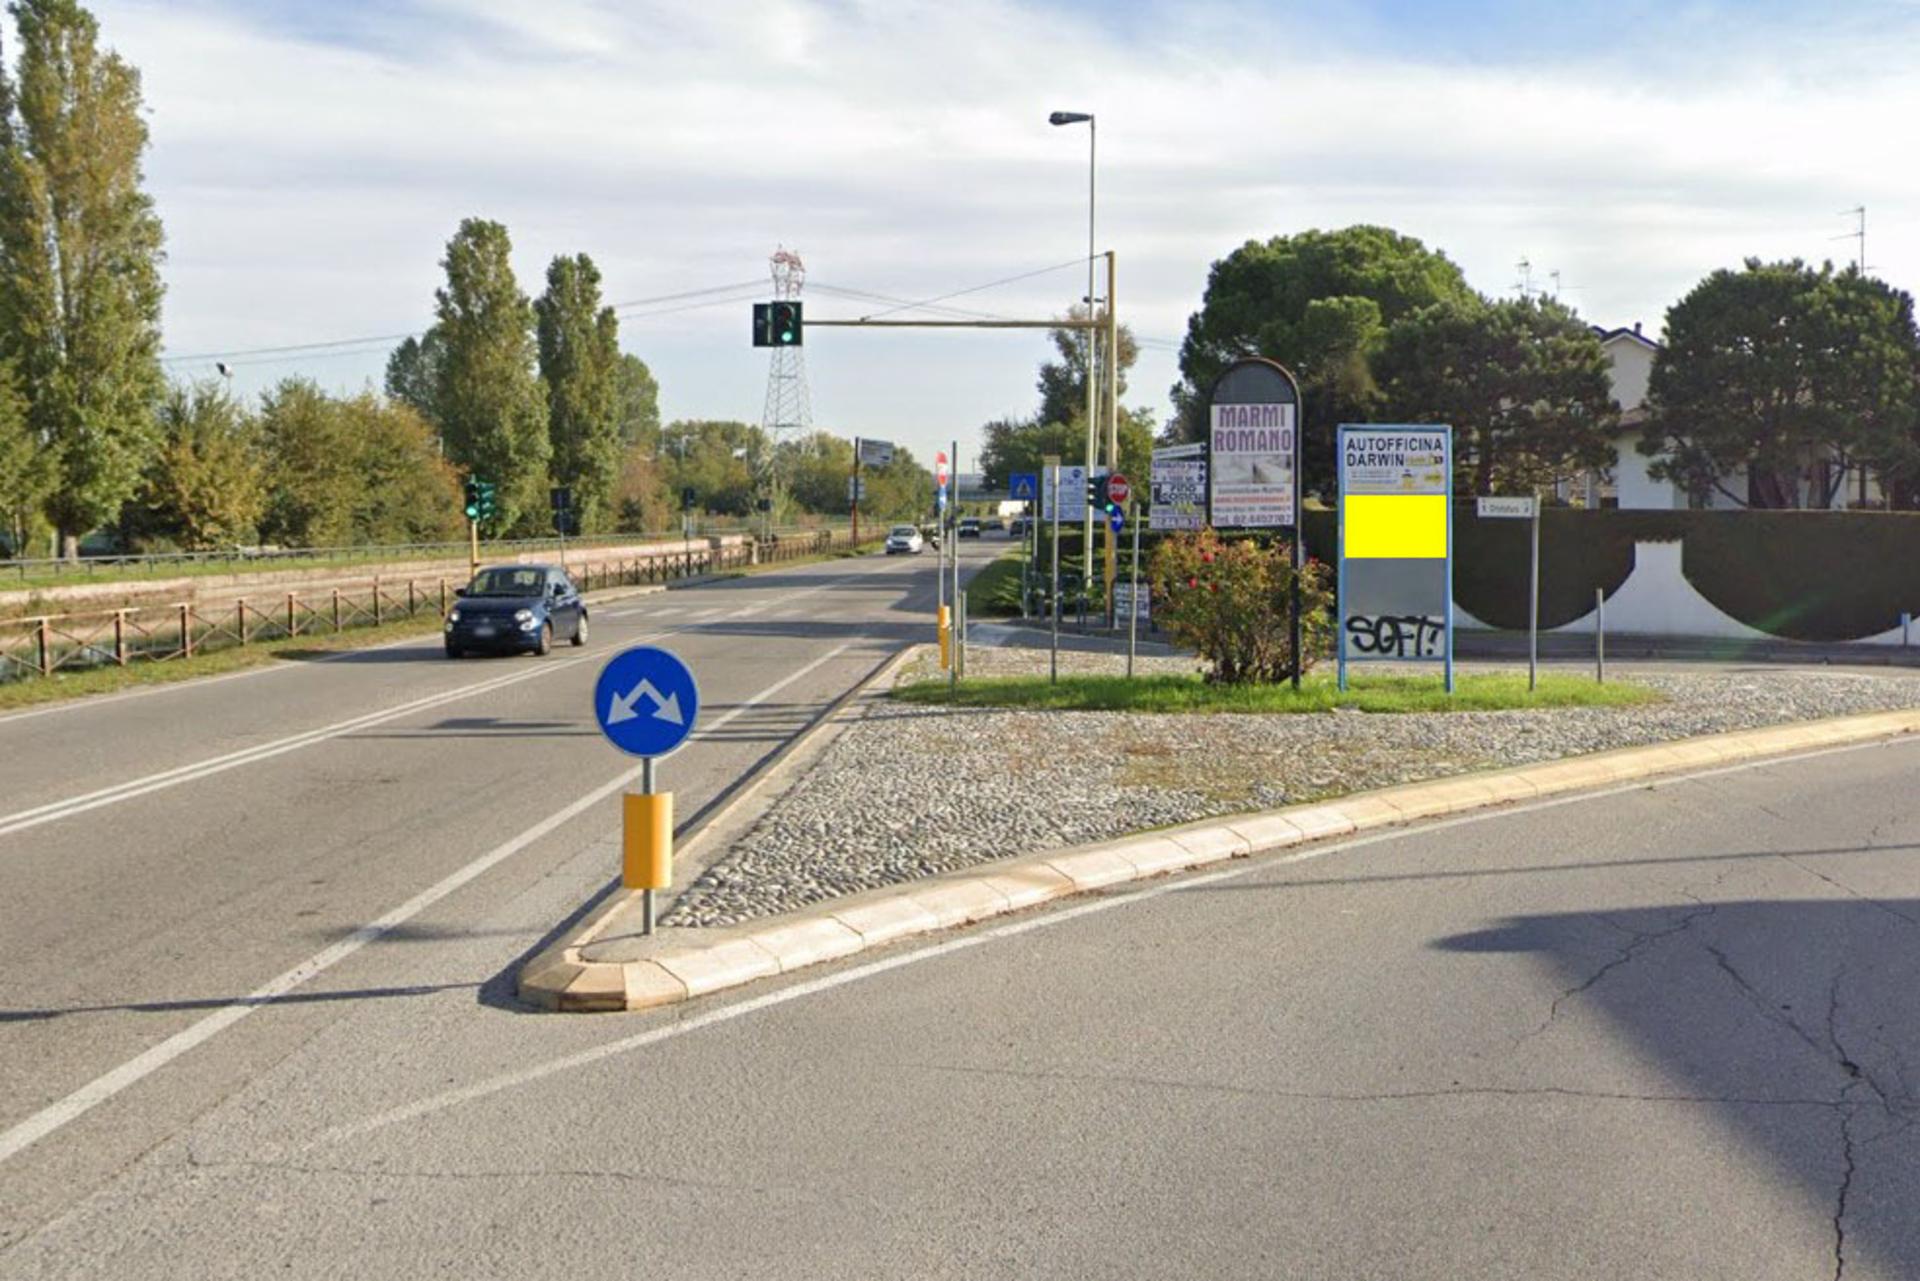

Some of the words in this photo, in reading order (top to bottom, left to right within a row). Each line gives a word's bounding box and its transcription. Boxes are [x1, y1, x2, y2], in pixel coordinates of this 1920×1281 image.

[1219, 407, 1286, 428] MARMI
[1214, 429, 1292, 452] ROMANO
[1346, 437, 1443, 451] AUTOFFICINA
[1346, 453, 1404, 467] DARWIN
